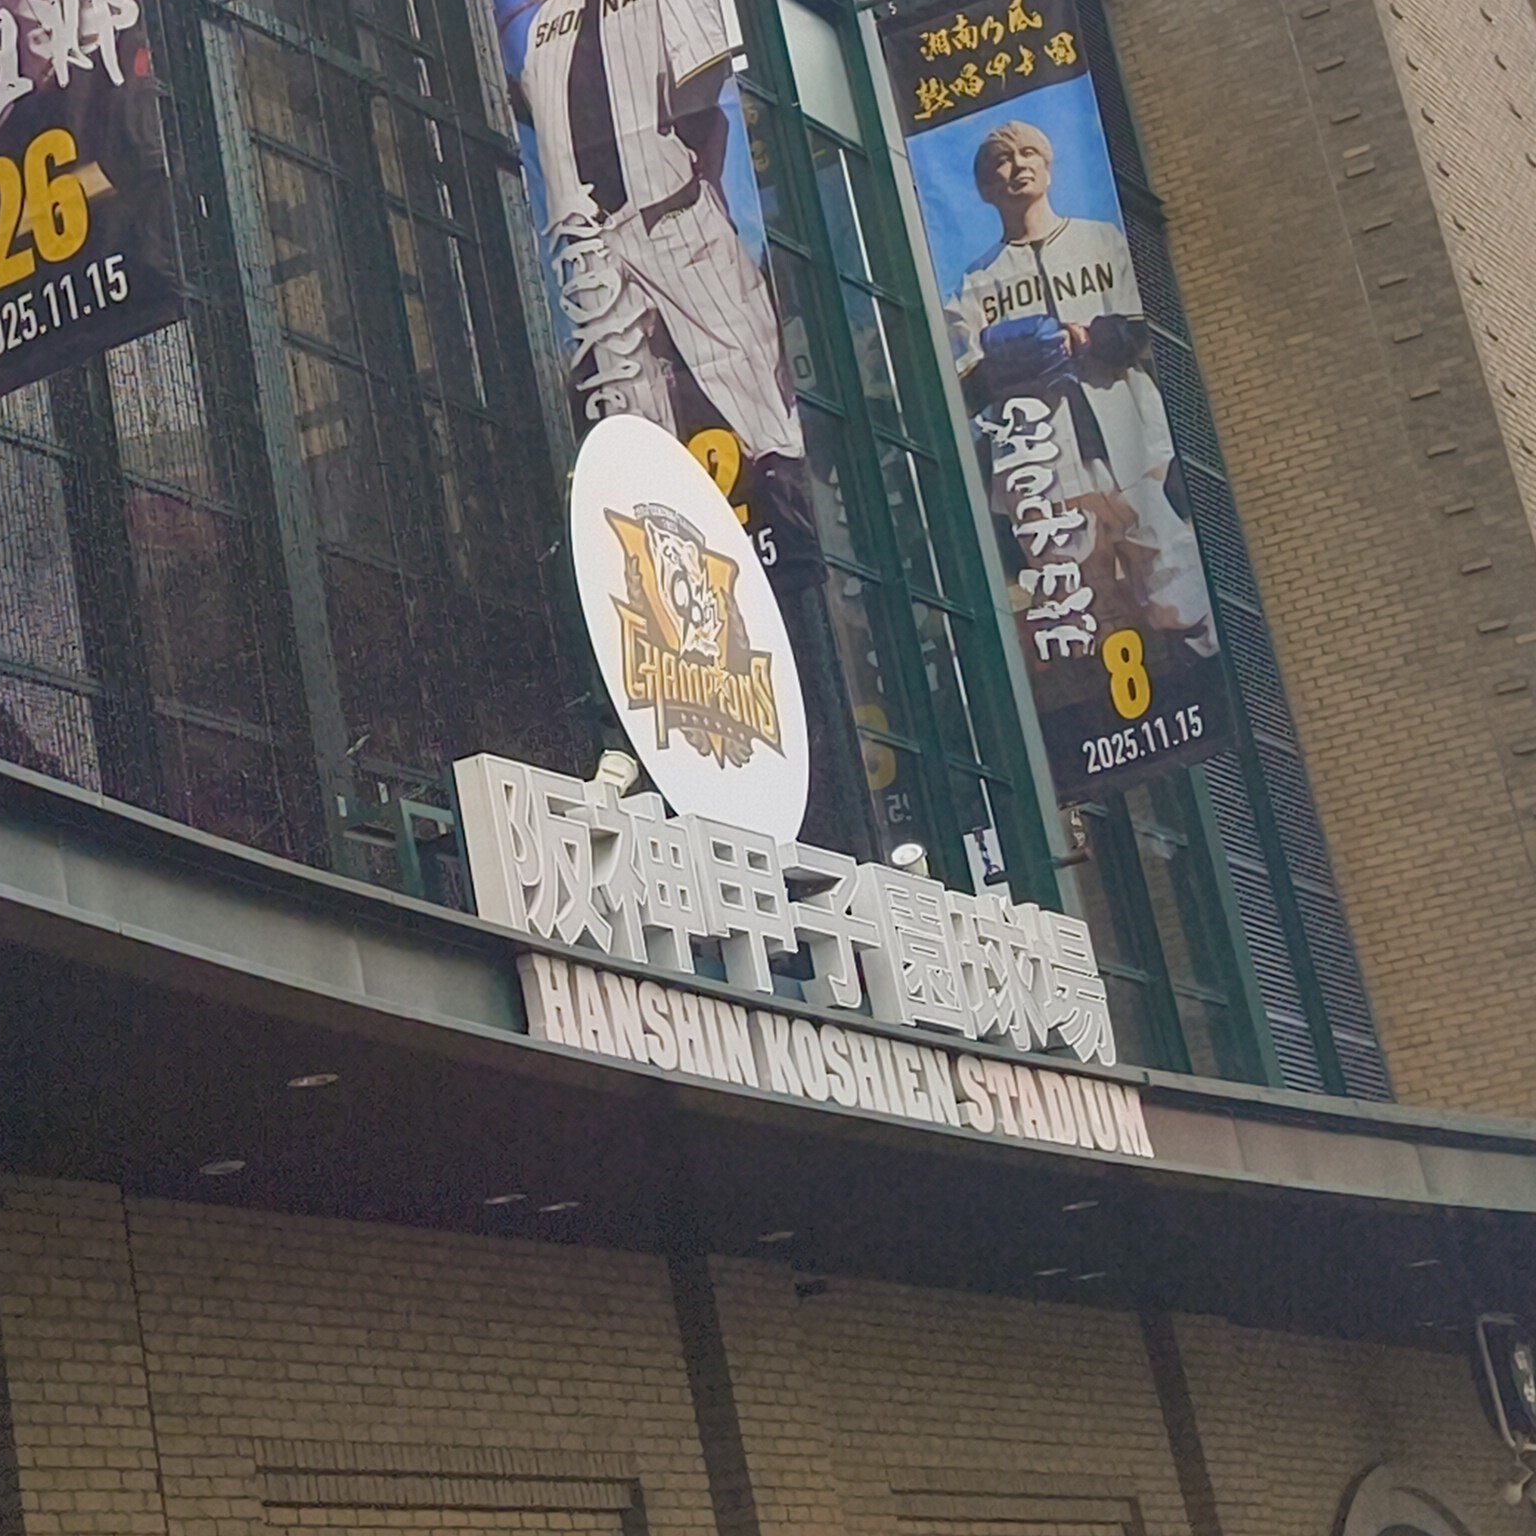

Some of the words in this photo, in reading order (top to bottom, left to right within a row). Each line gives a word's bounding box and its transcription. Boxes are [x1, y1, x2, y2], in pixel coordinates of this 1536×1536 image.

[1081, 704, 1204, 775] 2025.11.15
[1101, 628, 1153, 721] 8
[456, 752, 1117, 1068] 阪神甲子園球場
[518, 952, 760, 1089] HANSHIN
[752, 1010, 963, 1129] KOSHIEN
[957, 1054, 1156, 1159] STADIUM
